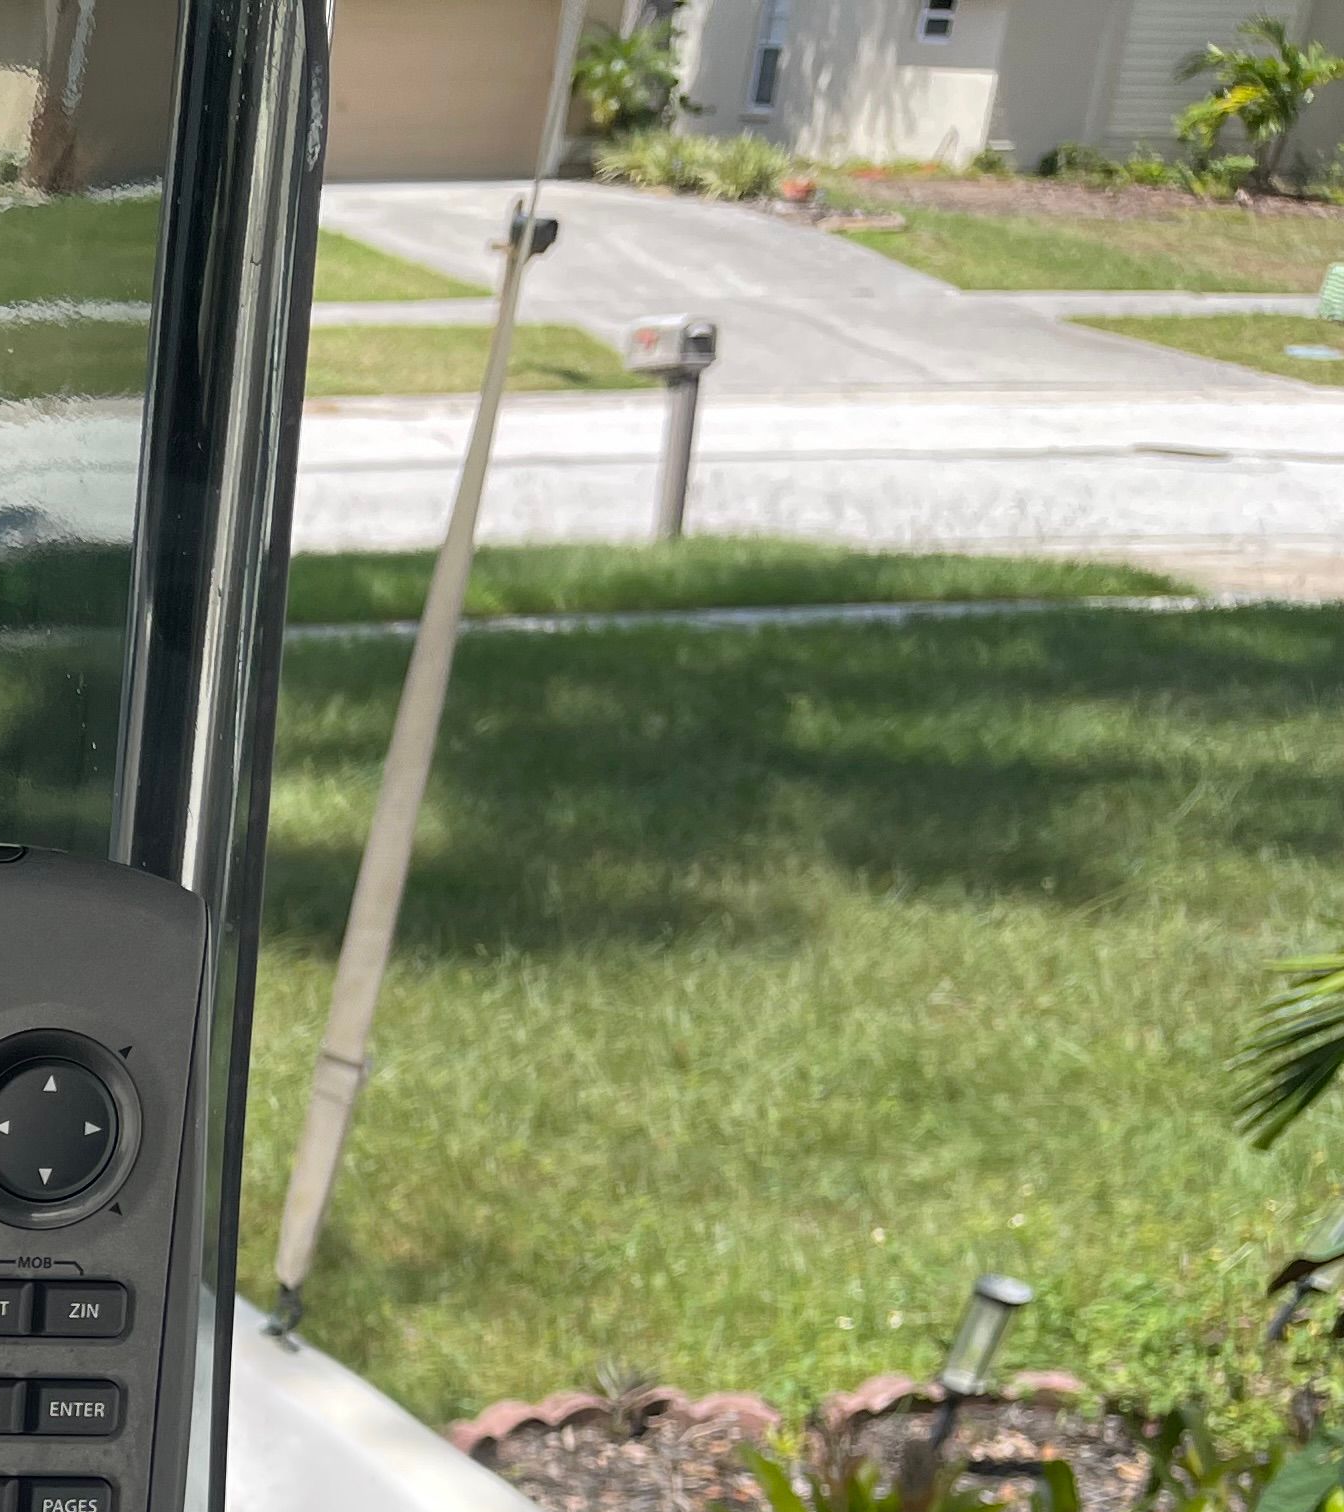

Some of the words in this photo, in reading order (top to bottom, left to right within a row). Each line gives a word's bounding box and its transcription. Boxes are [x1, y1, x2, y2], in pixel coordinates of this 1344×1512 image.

[18, 1256, 52, 1269] MOB
[69, 1303, 99, 1319] ZIN
[49, 1402, 105, 1418] ENTER
